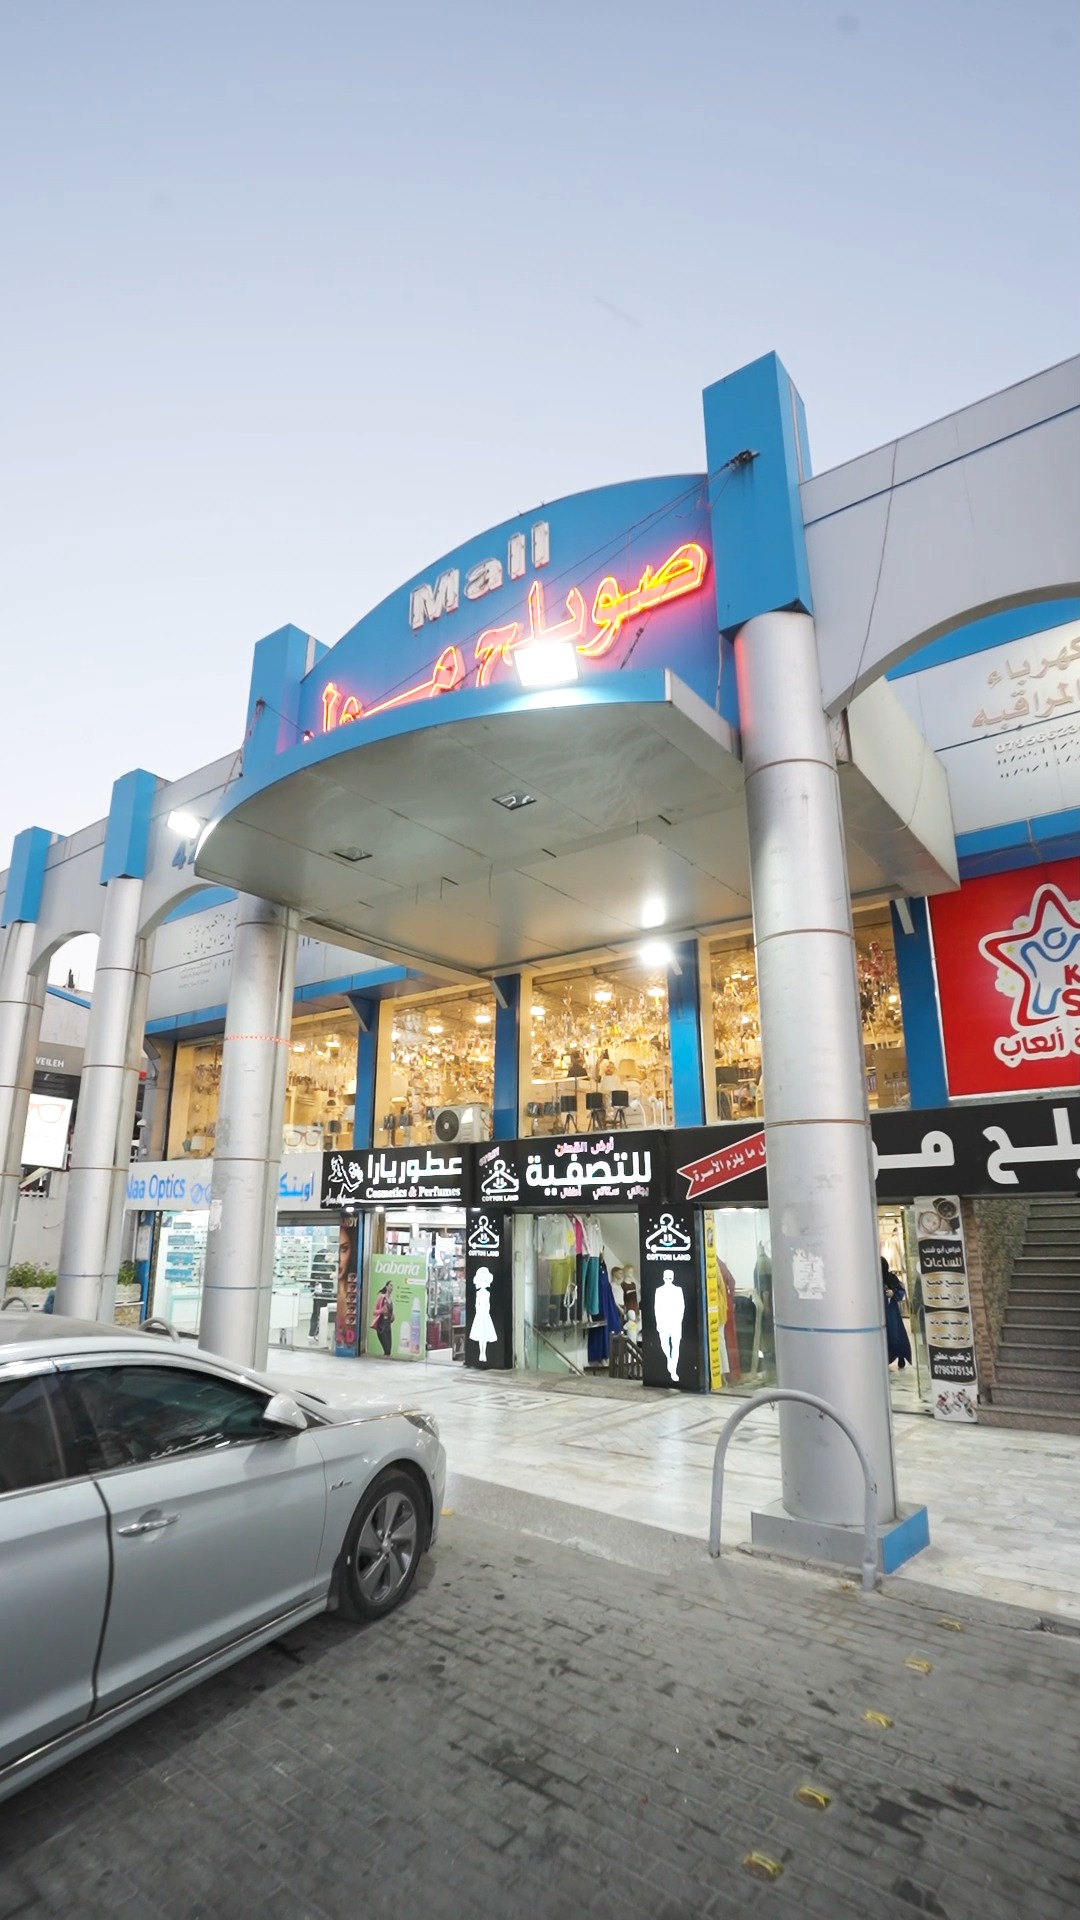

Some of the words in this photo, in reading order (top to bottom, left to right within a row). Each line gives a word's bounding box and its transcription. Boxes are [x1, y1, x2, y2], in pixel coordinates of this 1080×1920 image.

[411, 520, 550, 630] Mall
[1000, 1026, 1065, 1061] ألعاب
[398, 1151, 462, 1184] عطور
[525, 1151, 652, 1196] للتصفية
[148, 1173, 186, 1206] Optics
[366, 1186, 407, 1198] Cosmetics
[408, 1185, 417, 1197] &
[418, 1185, 461, 1198] Perfumes
[504, 1194, 519, 1202] LAND
[468, 1250, 486, 1258] COTTON
[646, 1253, 672, 1261] COTTON
[673, 1253, 691, 1261] LAND
[375, 1260, 420, 1276] babaria
[924, 1257, 963, 1268] للساعات
